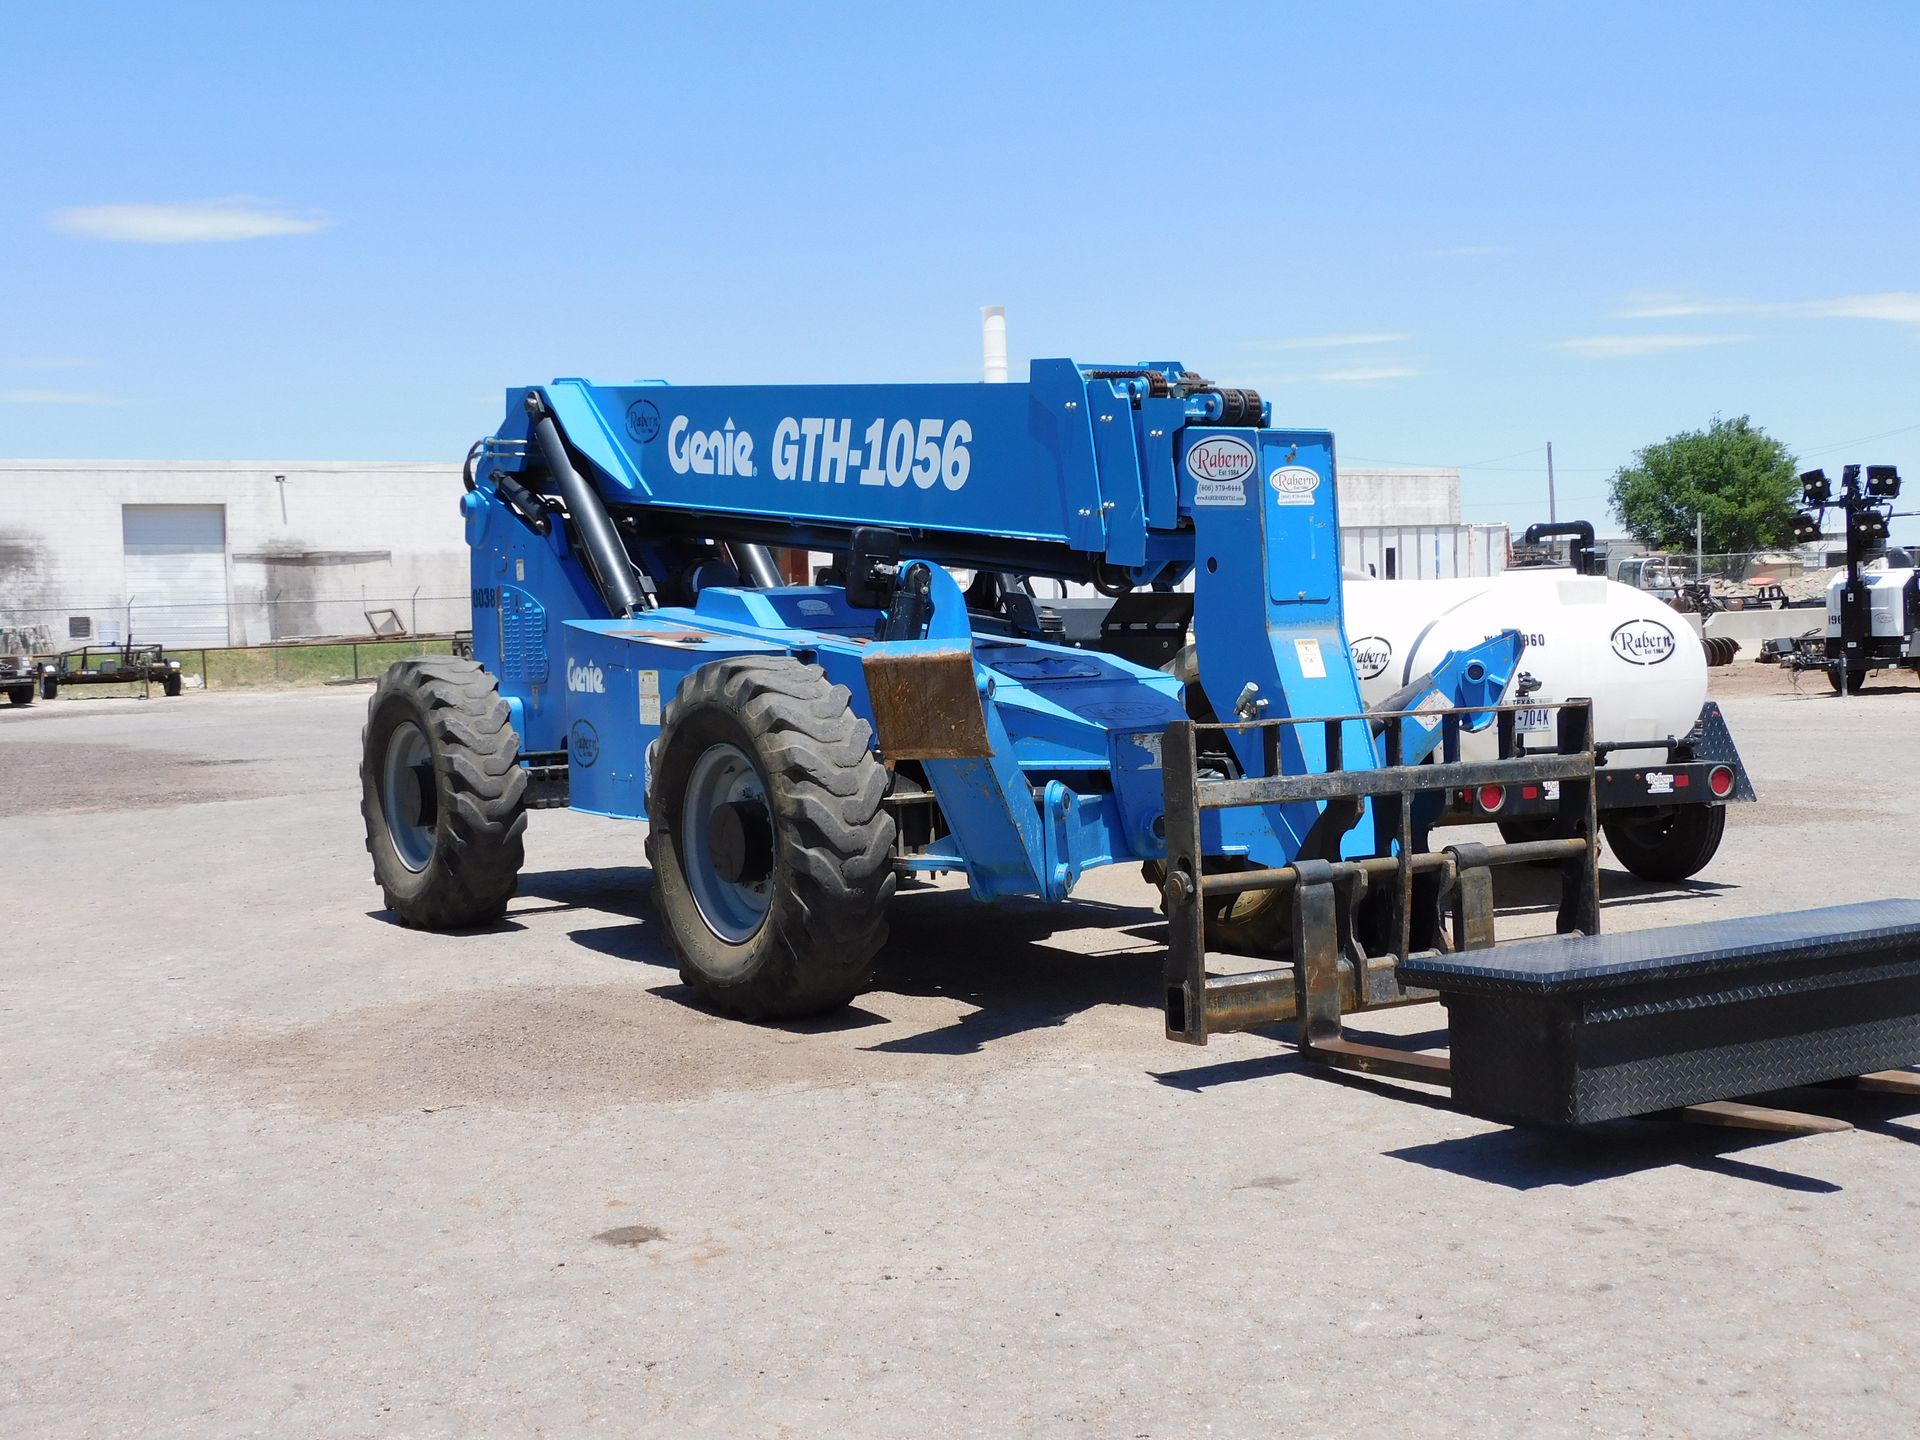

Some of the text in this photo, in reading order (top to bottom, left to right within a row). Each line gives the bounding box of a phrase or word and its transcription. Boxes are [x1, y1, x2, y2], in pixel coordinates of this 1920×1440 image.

[668, 415, 973, 491] Genie GTH-1056
[1193, 447, 1249, 477] Rabern
[1274, 474, 1315, 491] Rabern
[1615, 631, 1671, 656] Rabern
[567, 657, 605, 693] Genie
